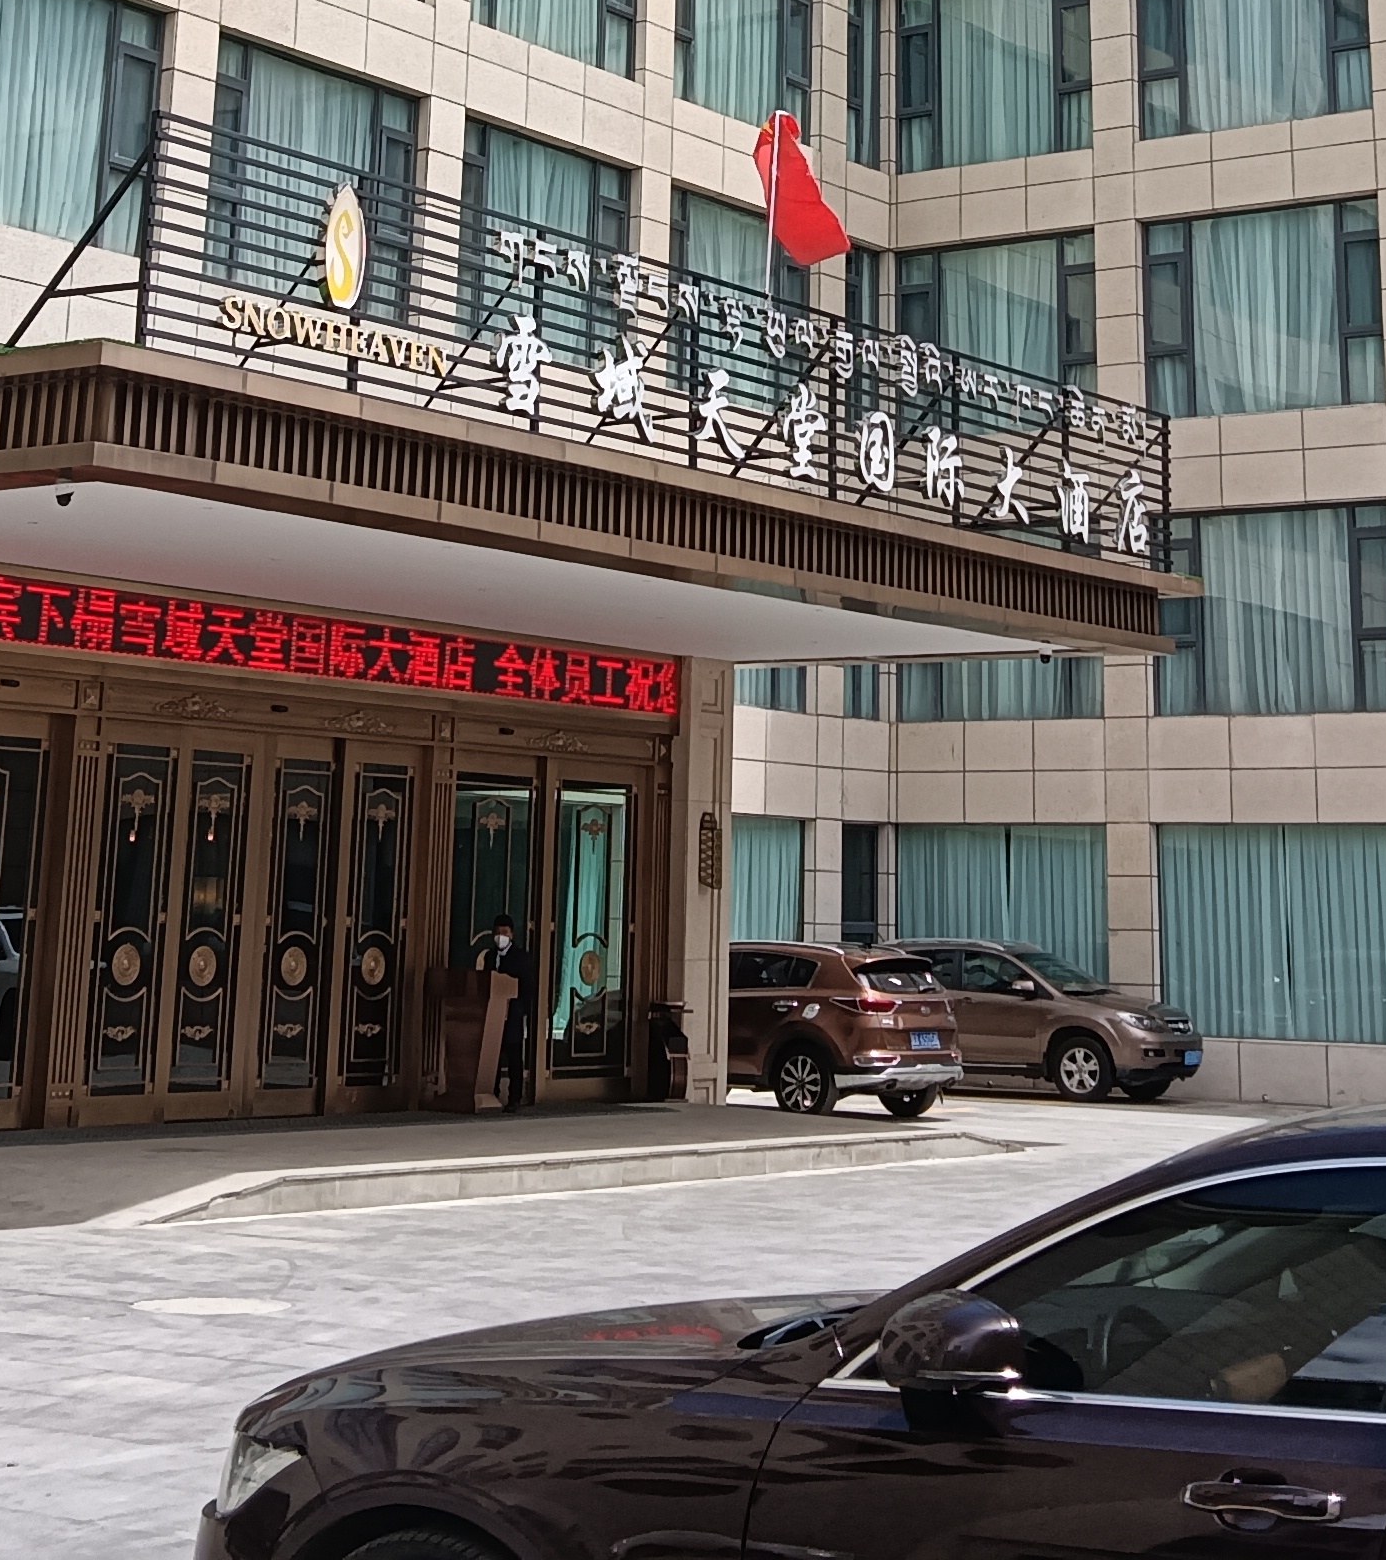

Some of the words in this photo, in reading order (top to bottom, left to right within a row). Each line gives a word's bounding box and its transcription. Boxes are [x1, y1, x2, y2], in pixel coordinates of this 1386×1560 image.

[220, 295, 448, 377] SNOWHEAVEN
[496, 314, 1149, 553] 雪域天堂国际大酒店
